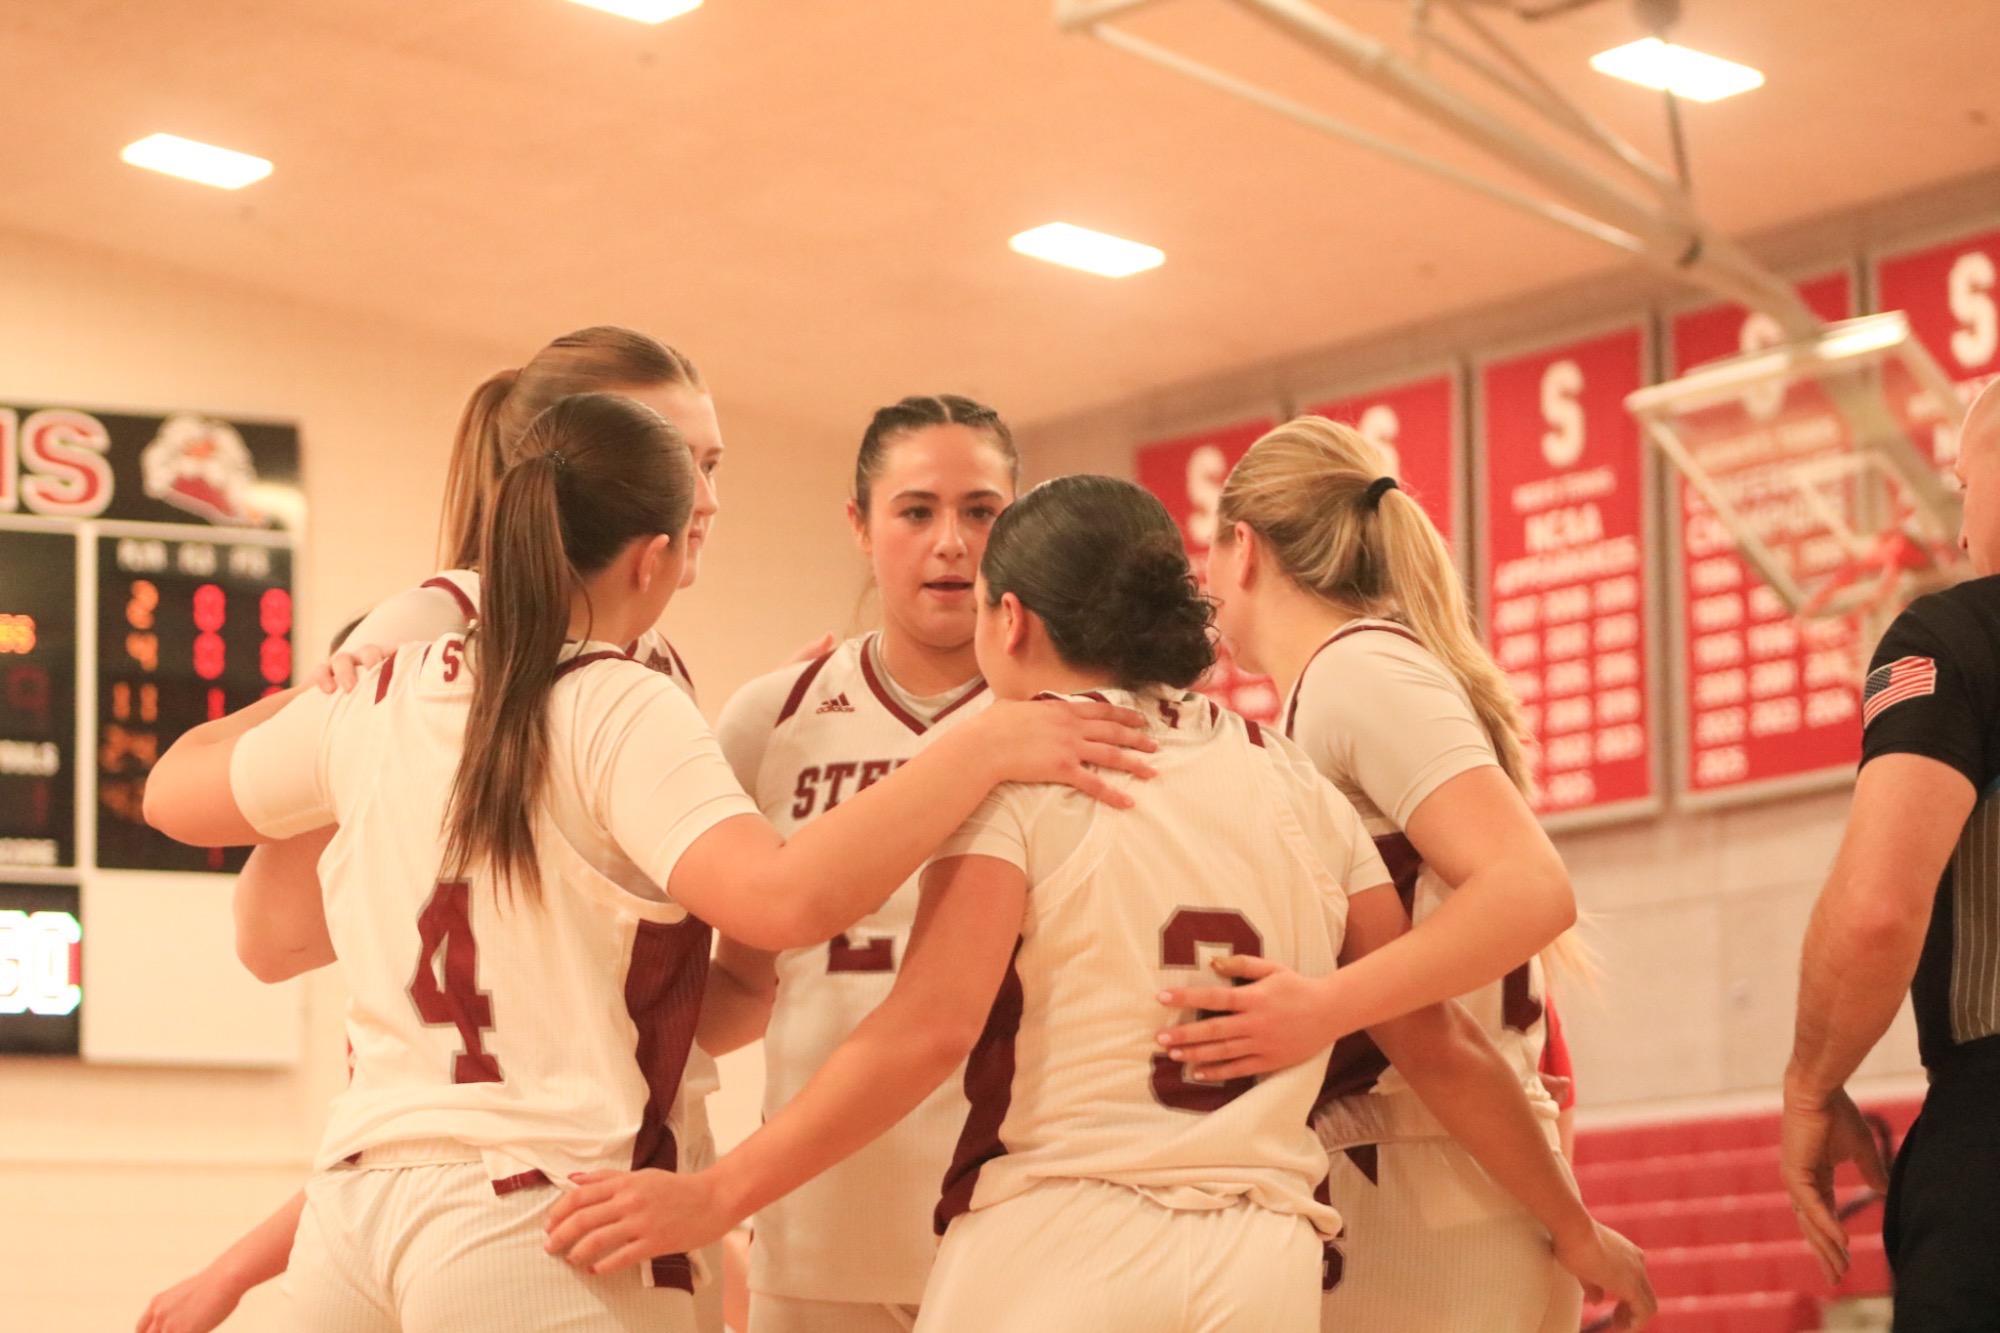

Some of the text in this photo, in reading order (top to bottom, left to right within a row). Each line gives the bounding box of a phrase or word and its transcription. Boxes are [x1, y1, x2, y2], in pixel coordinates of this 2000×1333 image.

[1948, 252, 1997, 367] S
[1540, 361, 1585, 468] S
[1186, 446, 1226, 545] S
[405, 878, 505, 1084] 4
